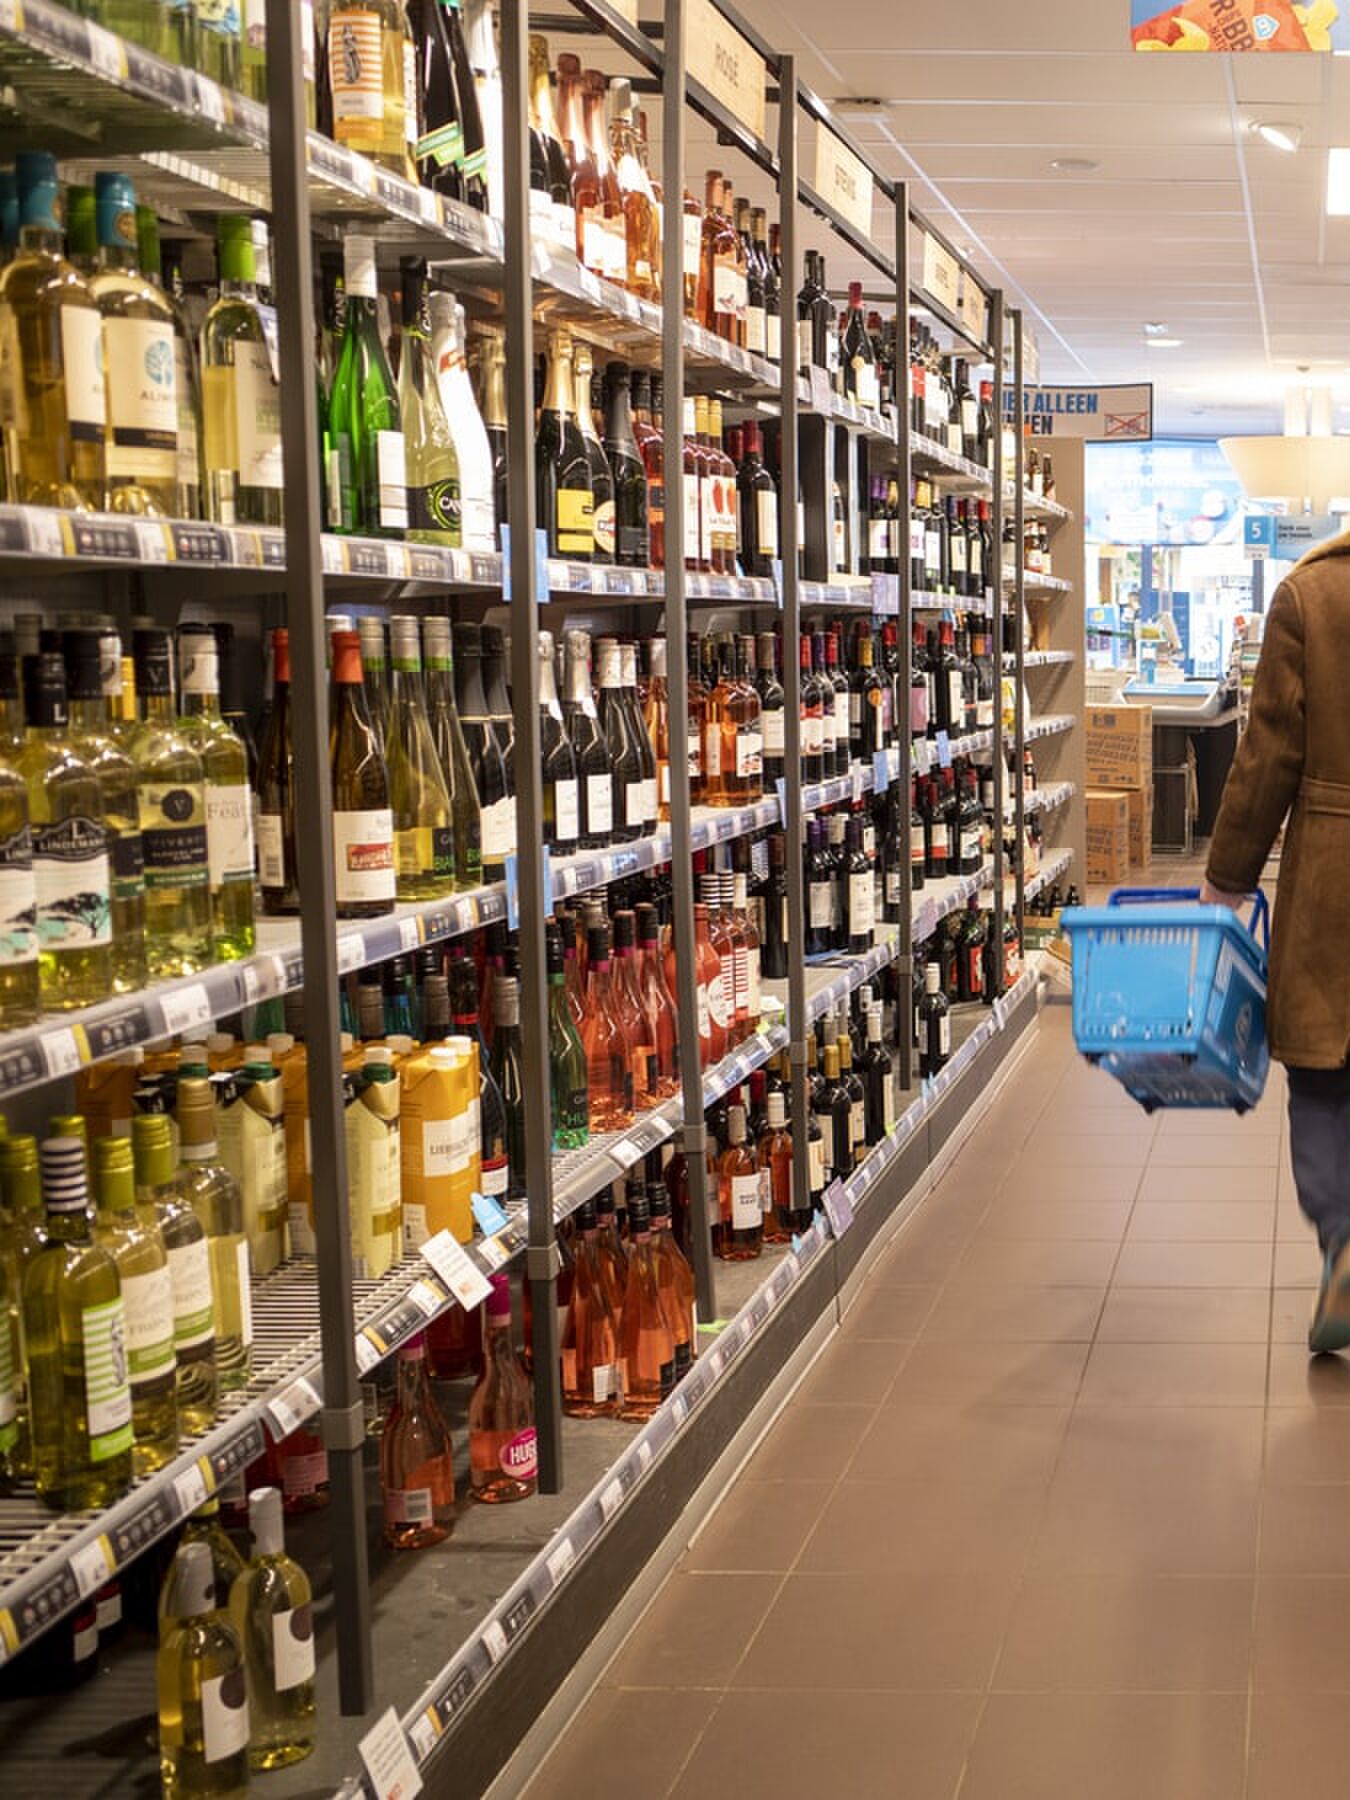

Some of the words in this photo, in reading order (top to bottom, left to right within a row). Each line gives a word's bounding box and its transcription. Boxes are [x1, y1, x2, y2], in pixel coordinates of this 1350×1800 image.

[1033, 392, 1098, 414] ALLEEN
[1251, 522, 1262, 539] 5
[511, 1437, 538, 1465] HUG
